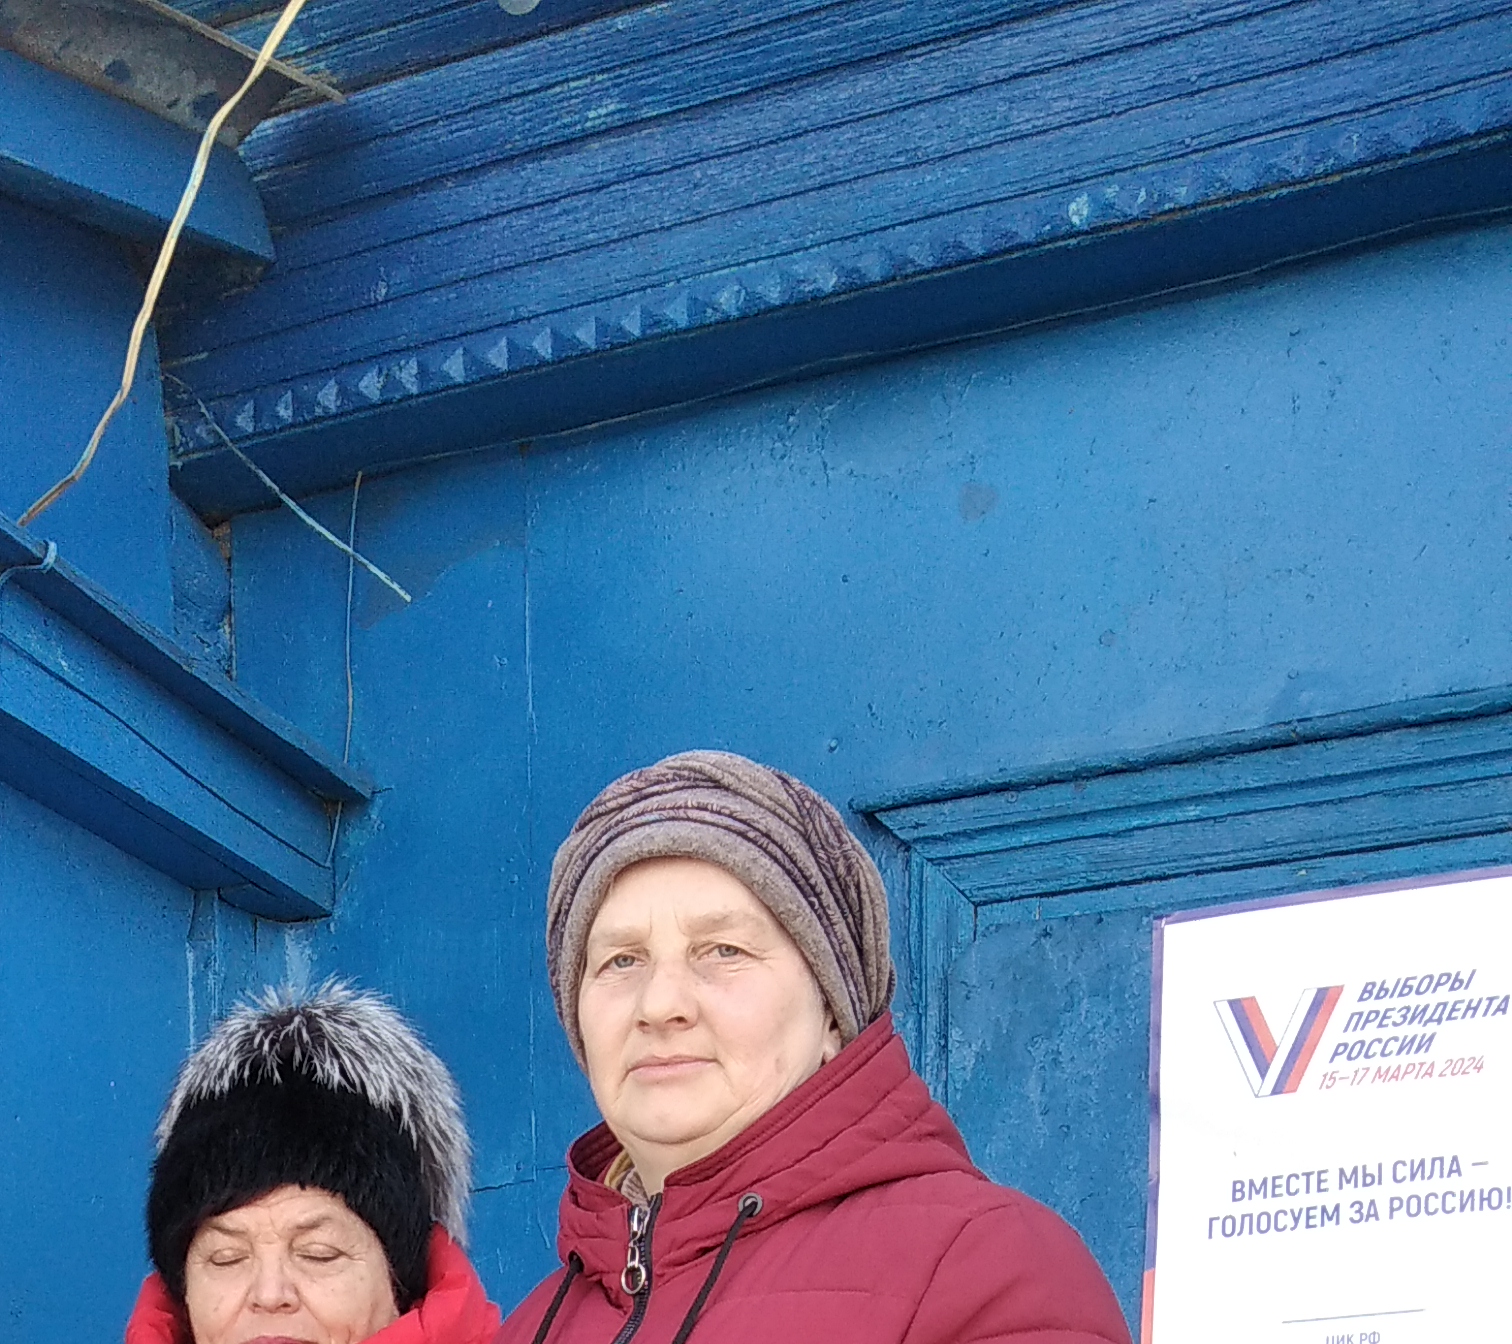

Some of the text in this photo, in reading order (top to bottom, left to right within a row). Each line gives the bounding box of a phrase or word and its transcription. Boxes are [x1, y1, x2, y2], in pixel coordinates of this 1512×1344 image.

[1356, 968, 1478, 1003] ВЫБОРЫ
[1342, 994, 1511, 1034] ПРЕЗИДЕНТА
[1328, 1031, 1438, 1064] РОССИИ
[1370, 1060, 1436, 1085] МАРТА
[1437, 1054, 1485, 1078] 2024
[1231, 1168, 1330, 1203] ВМЕСТЕ
[1338, 1162, 1383, 1191] МЫ
[1391, 1154, 1463, 1184] СИЛА
[1207, 1185, 1512, 1240] ГОЛОСУЕМ ЗА РОССИЮ!
